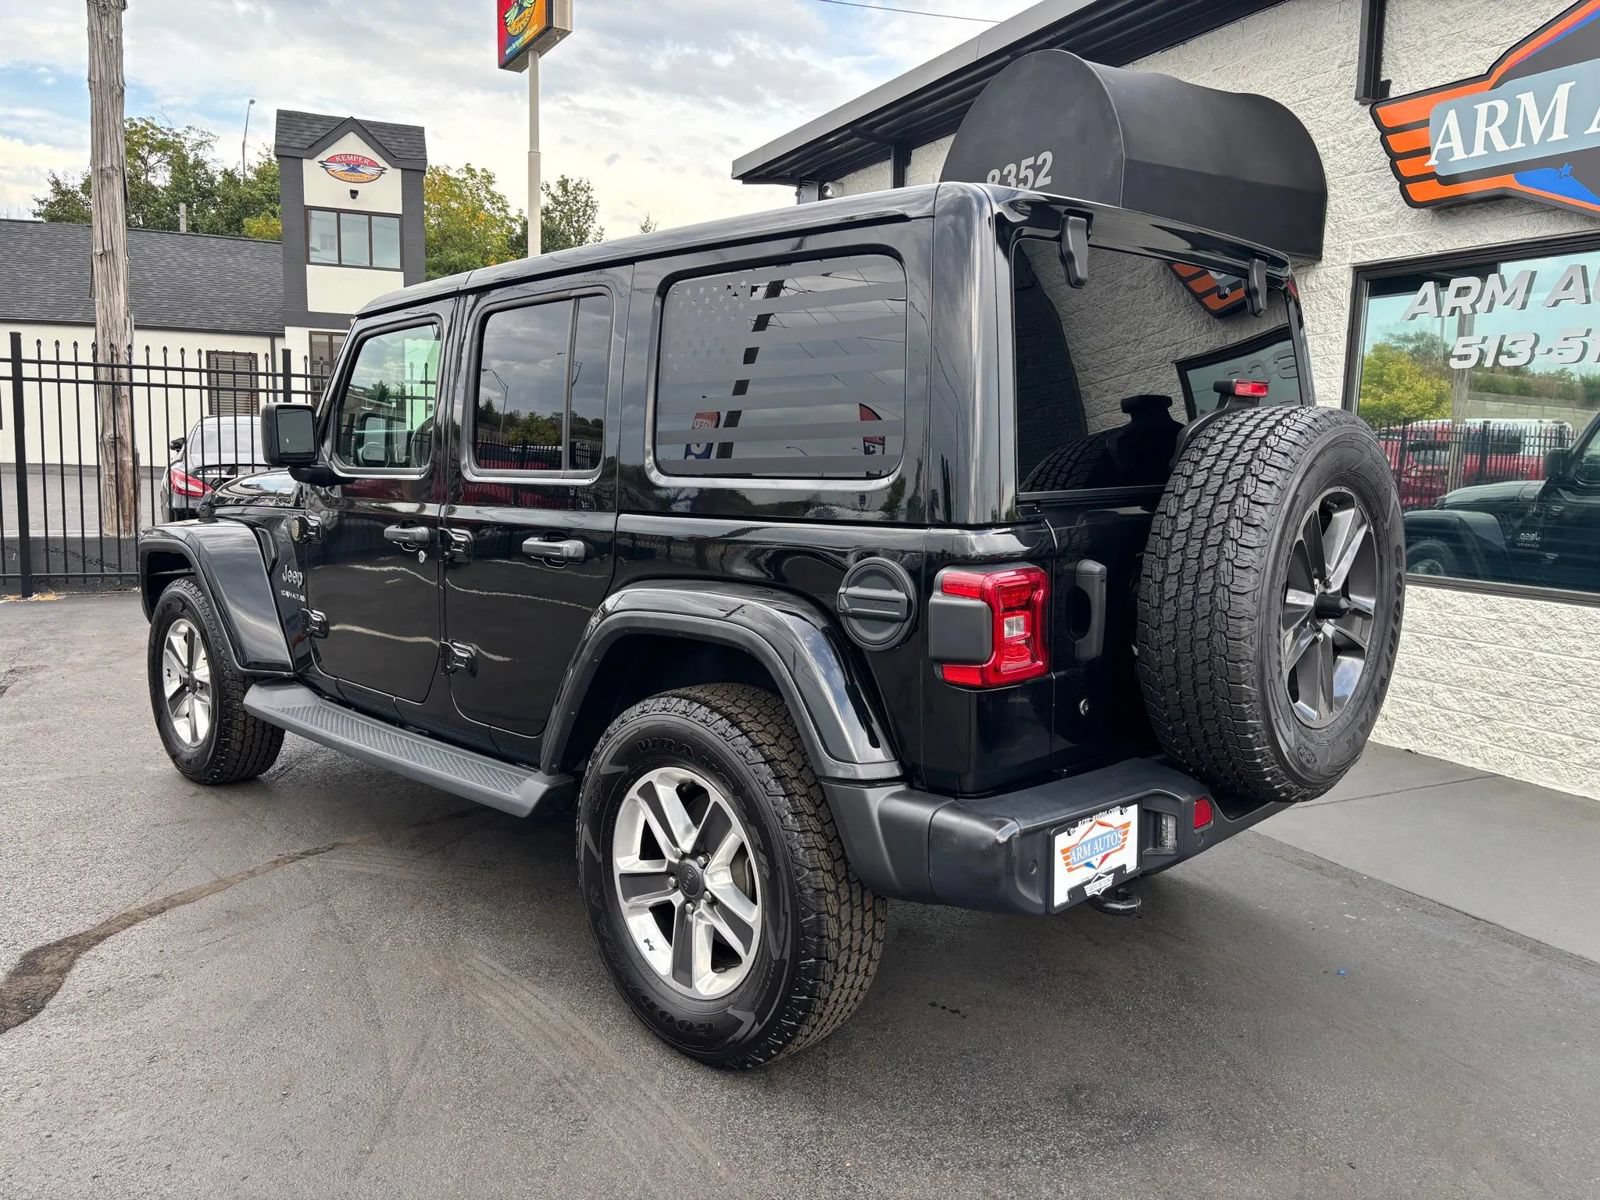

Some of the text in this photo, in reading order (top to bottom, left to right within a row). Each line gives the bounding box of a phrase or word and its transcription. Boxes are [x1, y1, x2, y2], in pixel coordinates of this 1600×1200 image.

[1424, 81, 1576, 166] ARM
[335, 154, 369, 165] KEMPER
[1401, 264, 1600, 321] ARM A
[282, 564, 303, 589] Jeep
[1070, 829, 1123, 864] ARM AUTOS
